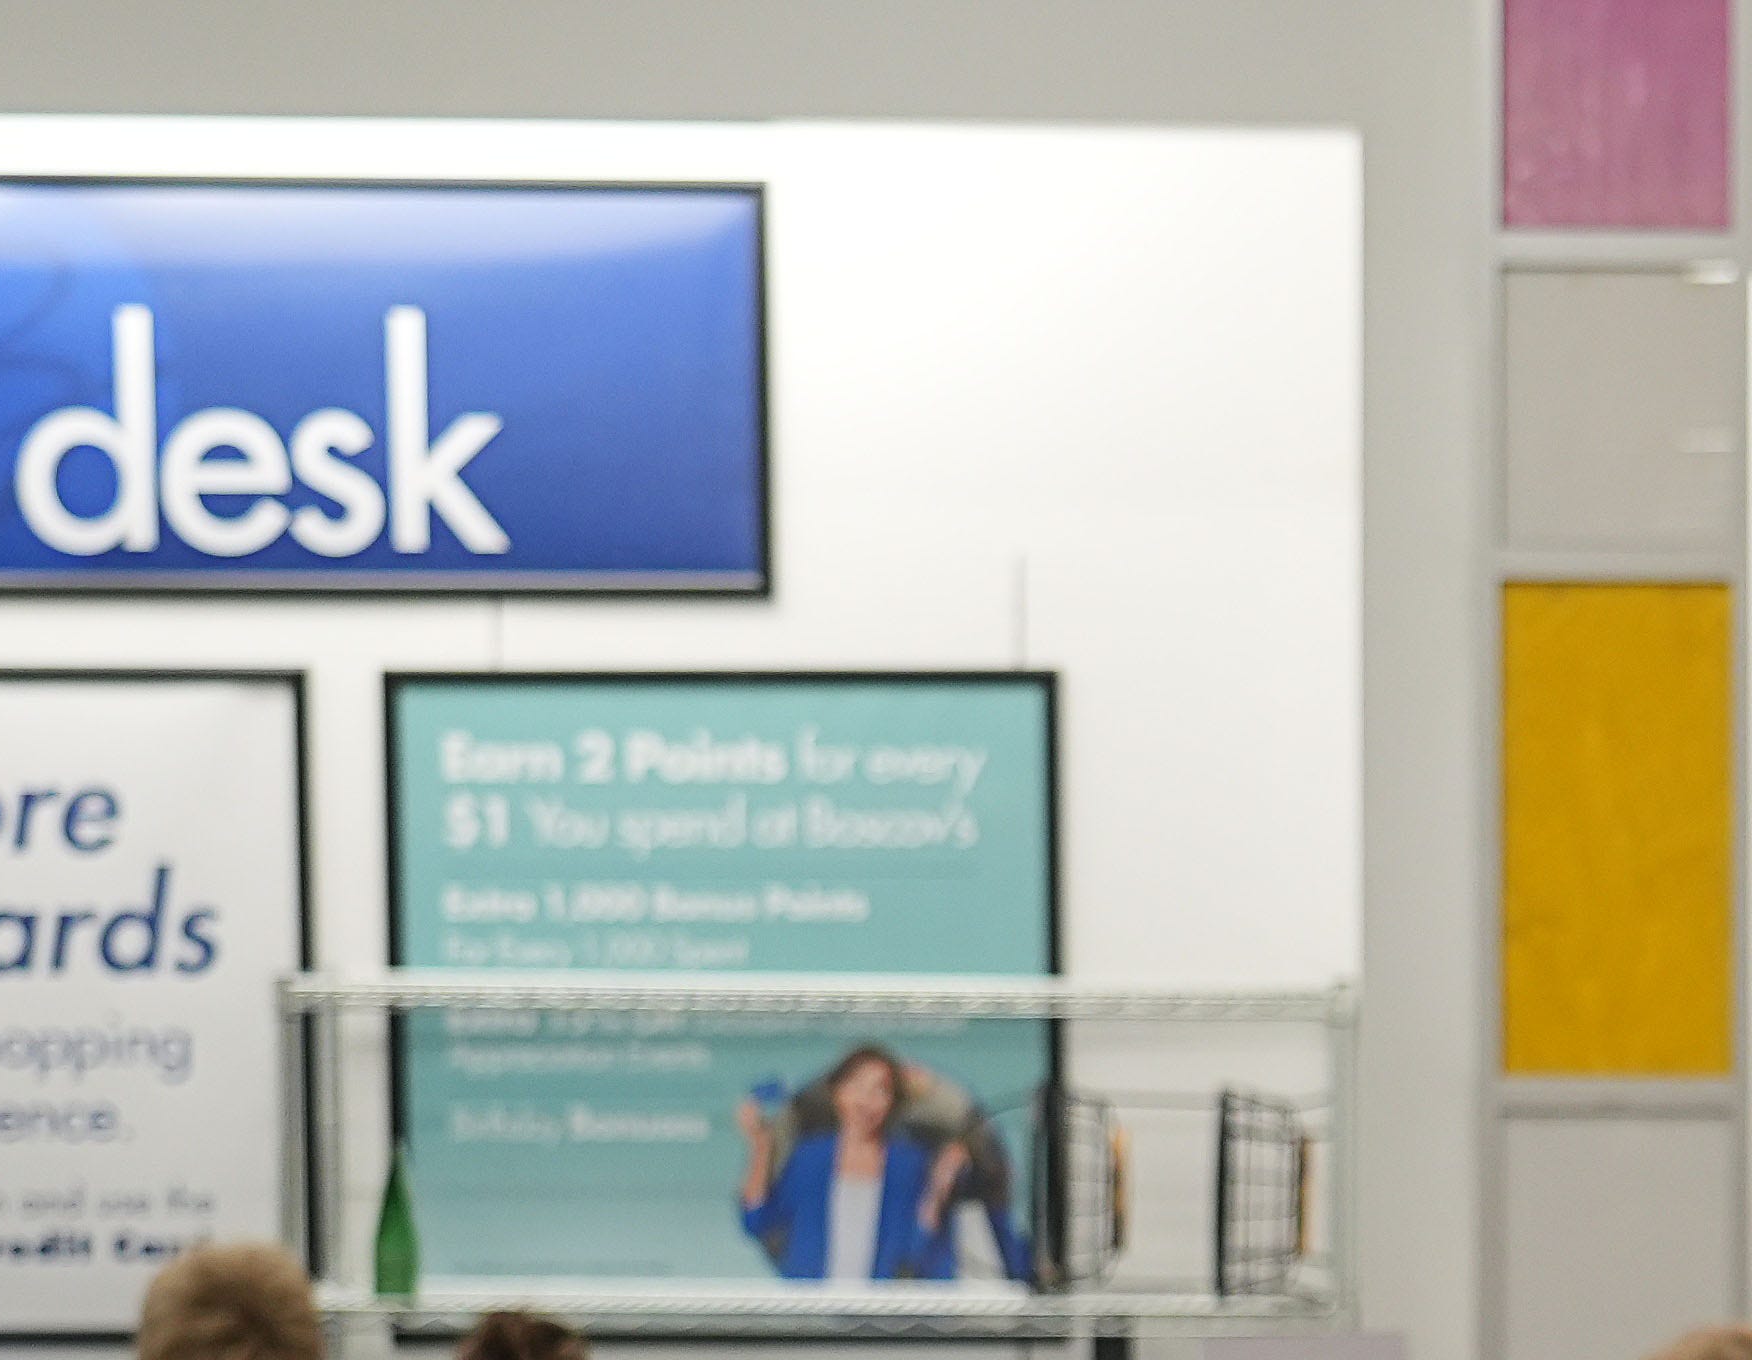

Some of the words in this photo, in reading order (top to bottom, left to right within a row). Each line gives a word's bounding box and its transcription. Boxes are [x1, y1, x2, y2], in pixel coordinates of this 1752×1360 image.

[14, 303, 510, 557] desk
[441, 728, 565, 784] Earn
[574, 727, 616, 785] 2
[625, 727, 789, 785] Points
[796, 724, 856, 783] for
[865, 742, 986, 796] every
[444, 792, 510, 851] $1
[524, 796, 609, 849] You
[617, 792, 747, 860] spend
[754, 802, 799, 849] at
